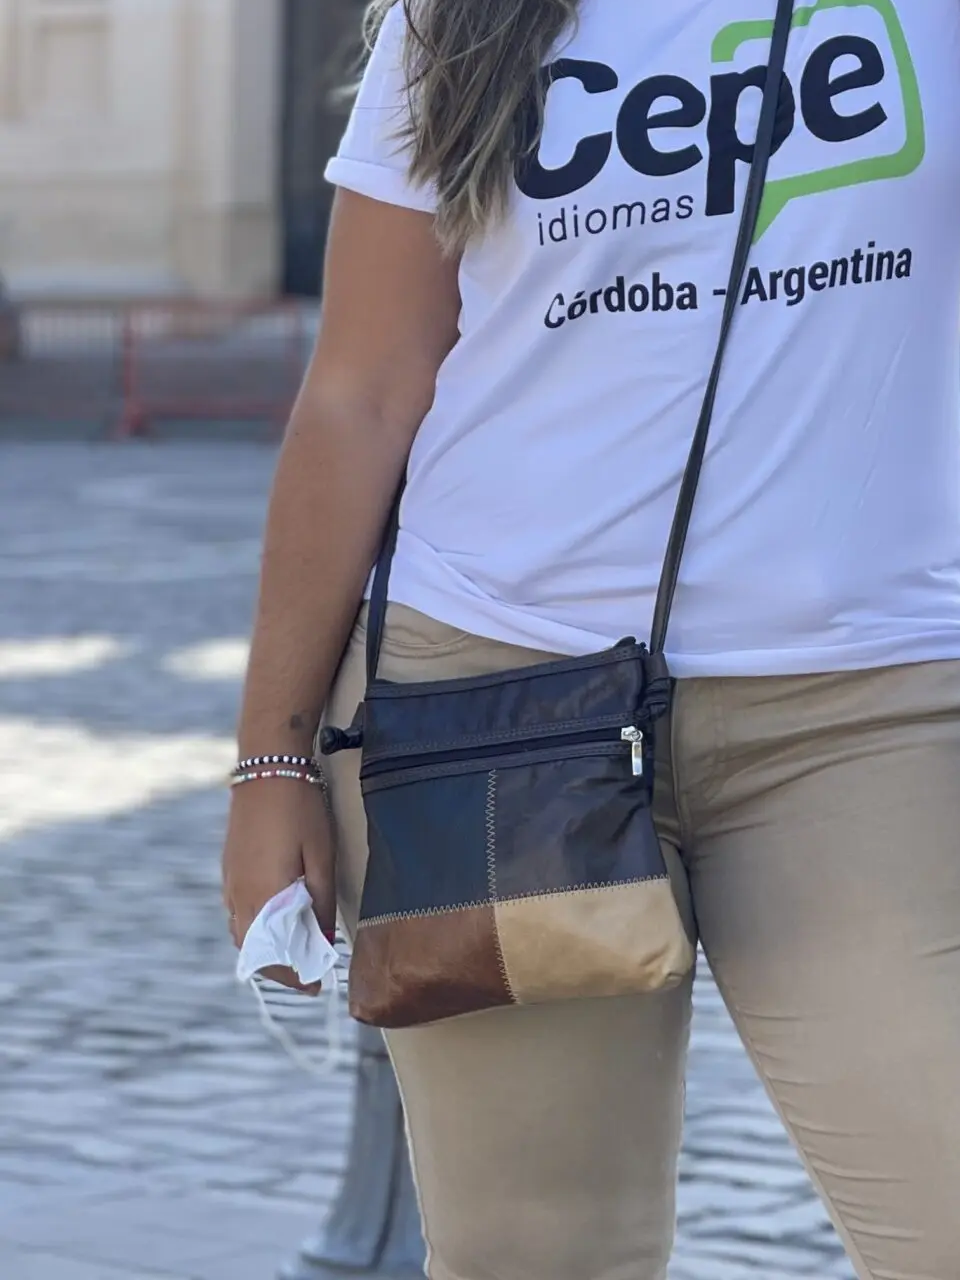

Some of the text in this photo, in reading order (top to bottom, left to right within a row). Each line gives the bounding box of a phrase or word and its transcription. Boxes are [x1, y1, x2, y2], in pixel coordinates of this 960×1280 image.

[513, 35, 888, 217] Cepe
[537, 195, 695, 246] idiomas
[543, 272, 698, 329] Córdoba
[741, 241, 913, 306] Argentina
